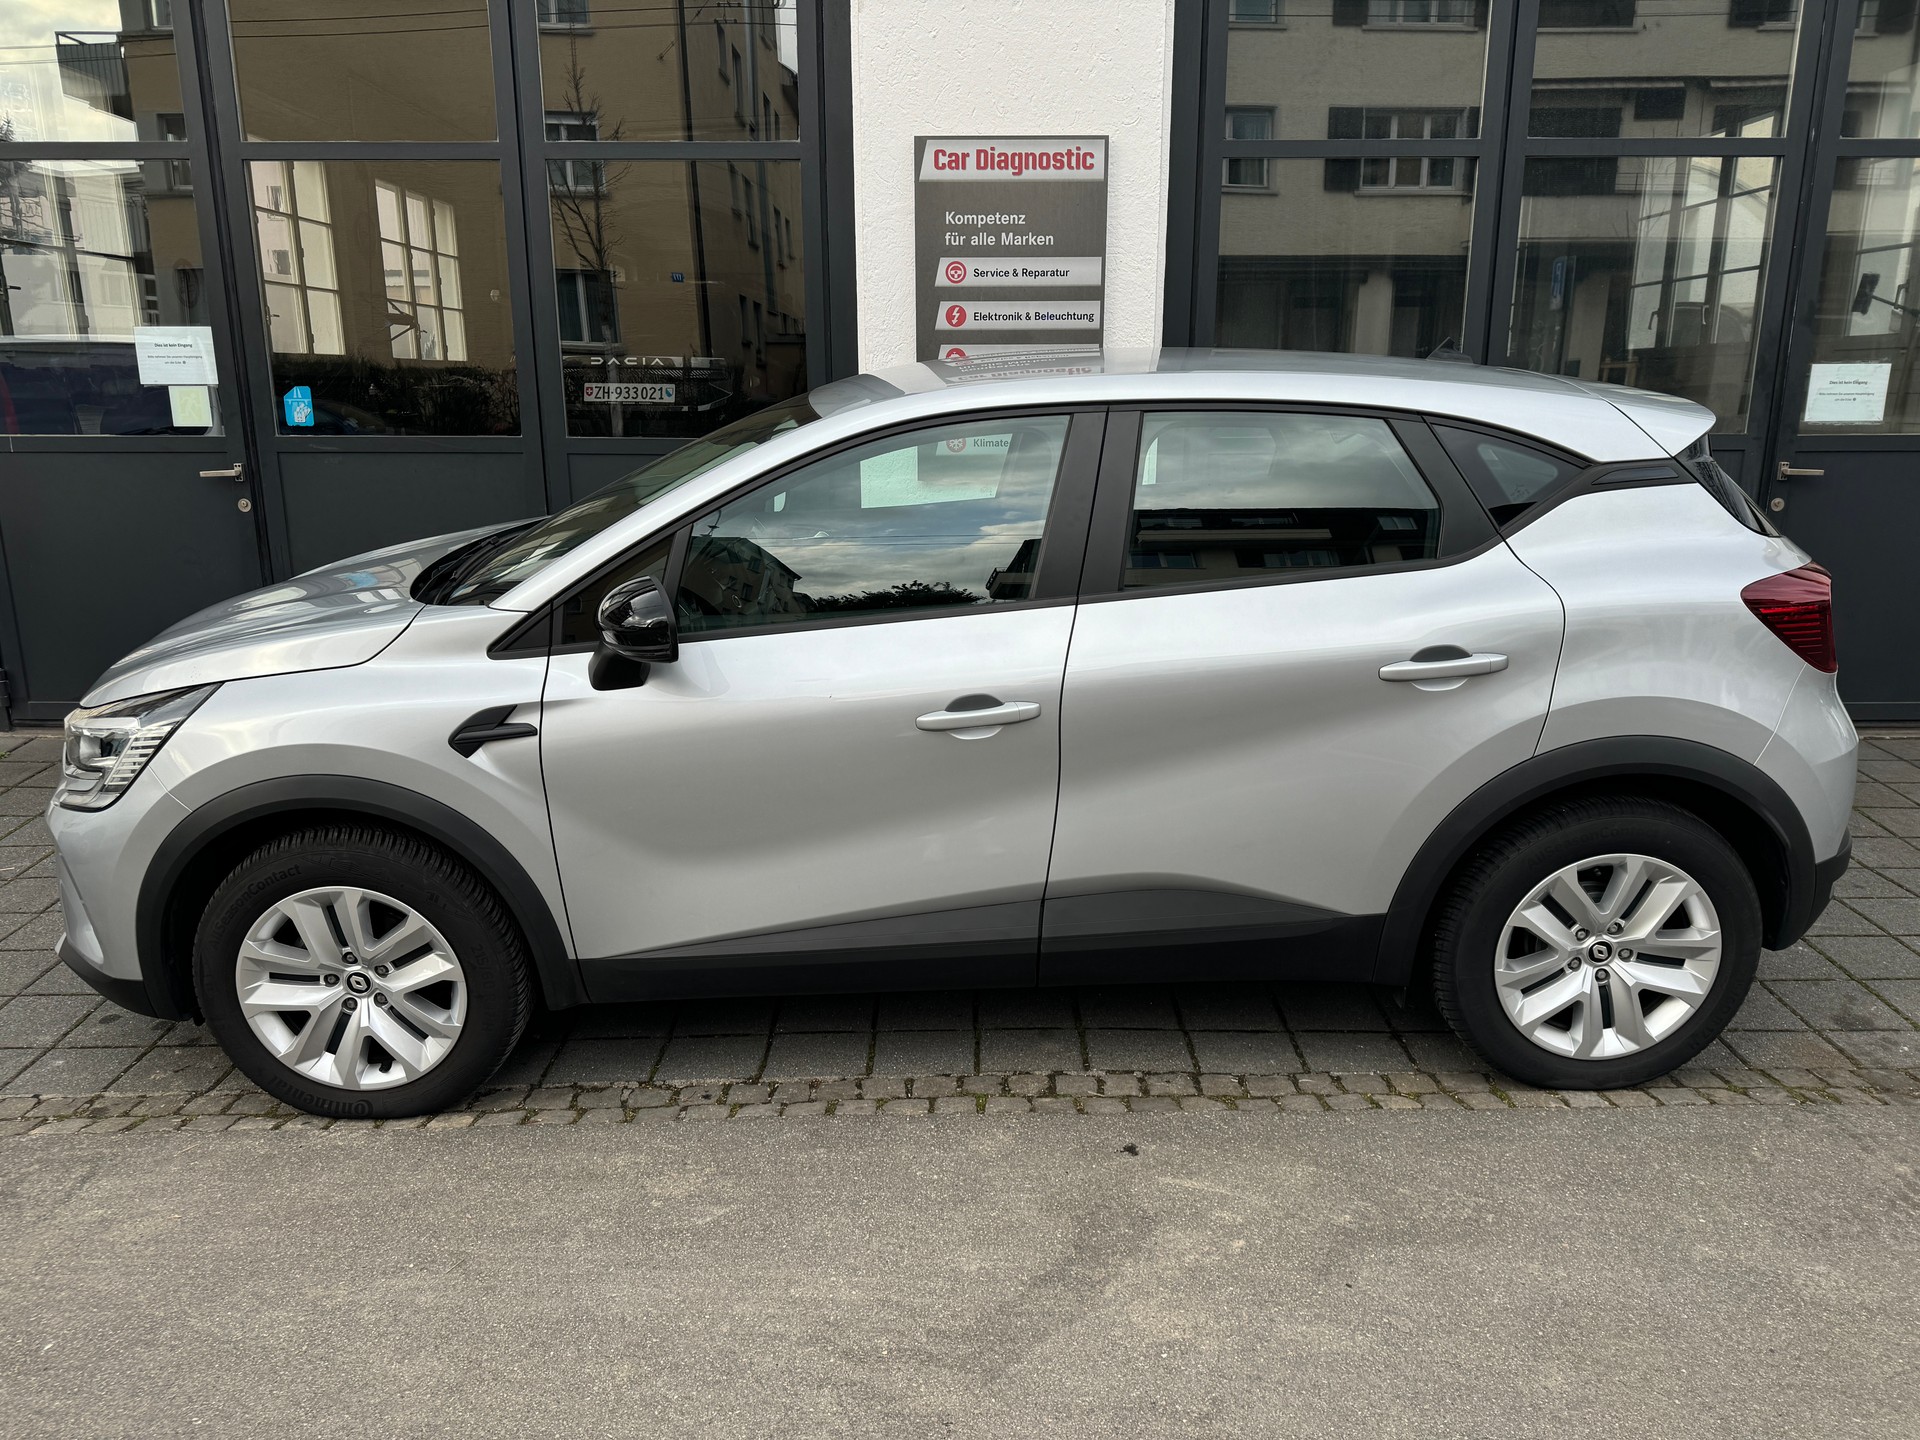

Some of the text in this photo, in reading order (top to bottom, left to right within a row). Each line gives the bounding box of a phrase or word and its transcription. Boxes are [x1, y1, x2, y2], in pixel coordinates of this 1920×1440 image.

[933, 146, 1095, 176] Car Diagnostic
[945, 211, 1026, 228] Kompetenz
[945, 232, 1054, 246] für alle Marken
[973, 268, 1070, 280] Service & Reparatur
[973, 312, 1095, 323] Elektronik & Beleuchtung
[590, 357, 664, 366] DACIA
[973, 438, 1009, 448] Klimate
